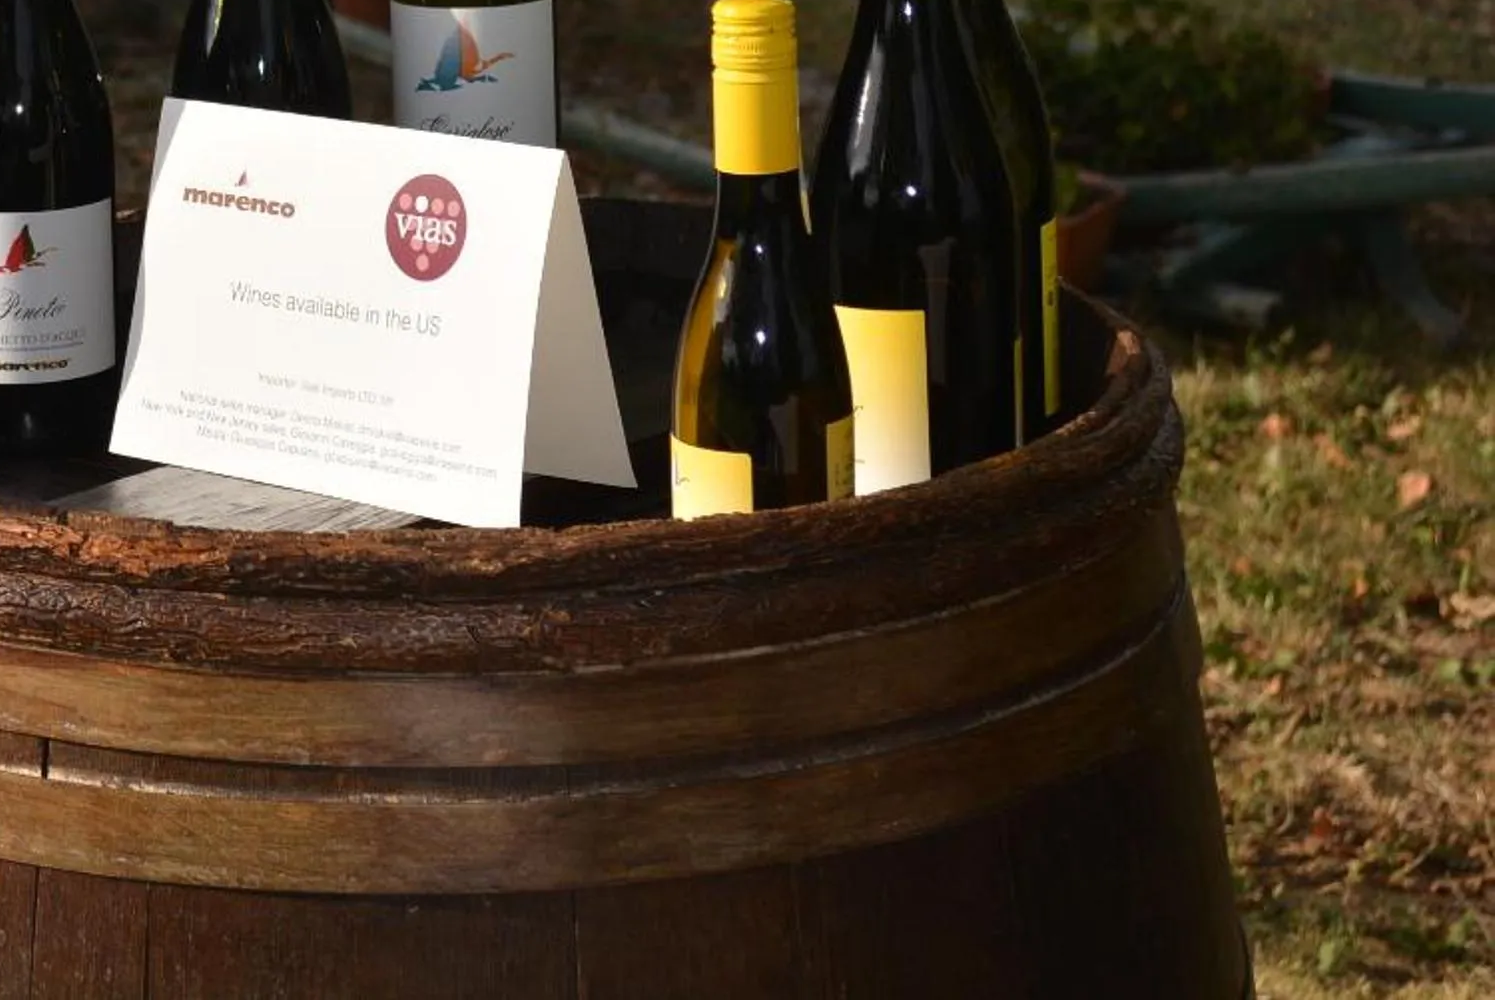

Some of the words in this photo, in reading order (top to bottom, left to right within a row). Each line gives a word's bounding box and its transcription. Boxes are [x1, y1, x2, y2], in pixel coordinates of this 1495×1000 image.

[183, 187, 295, 218] marenco
[394, 198, 457, 246] vias
[230, 281, 281, 309] Wines
[286, 293, 360, 321] available
[366, 306, 379, 325] in
[386, 308, 411, 331] the
[417, 312, 443, 336] US
